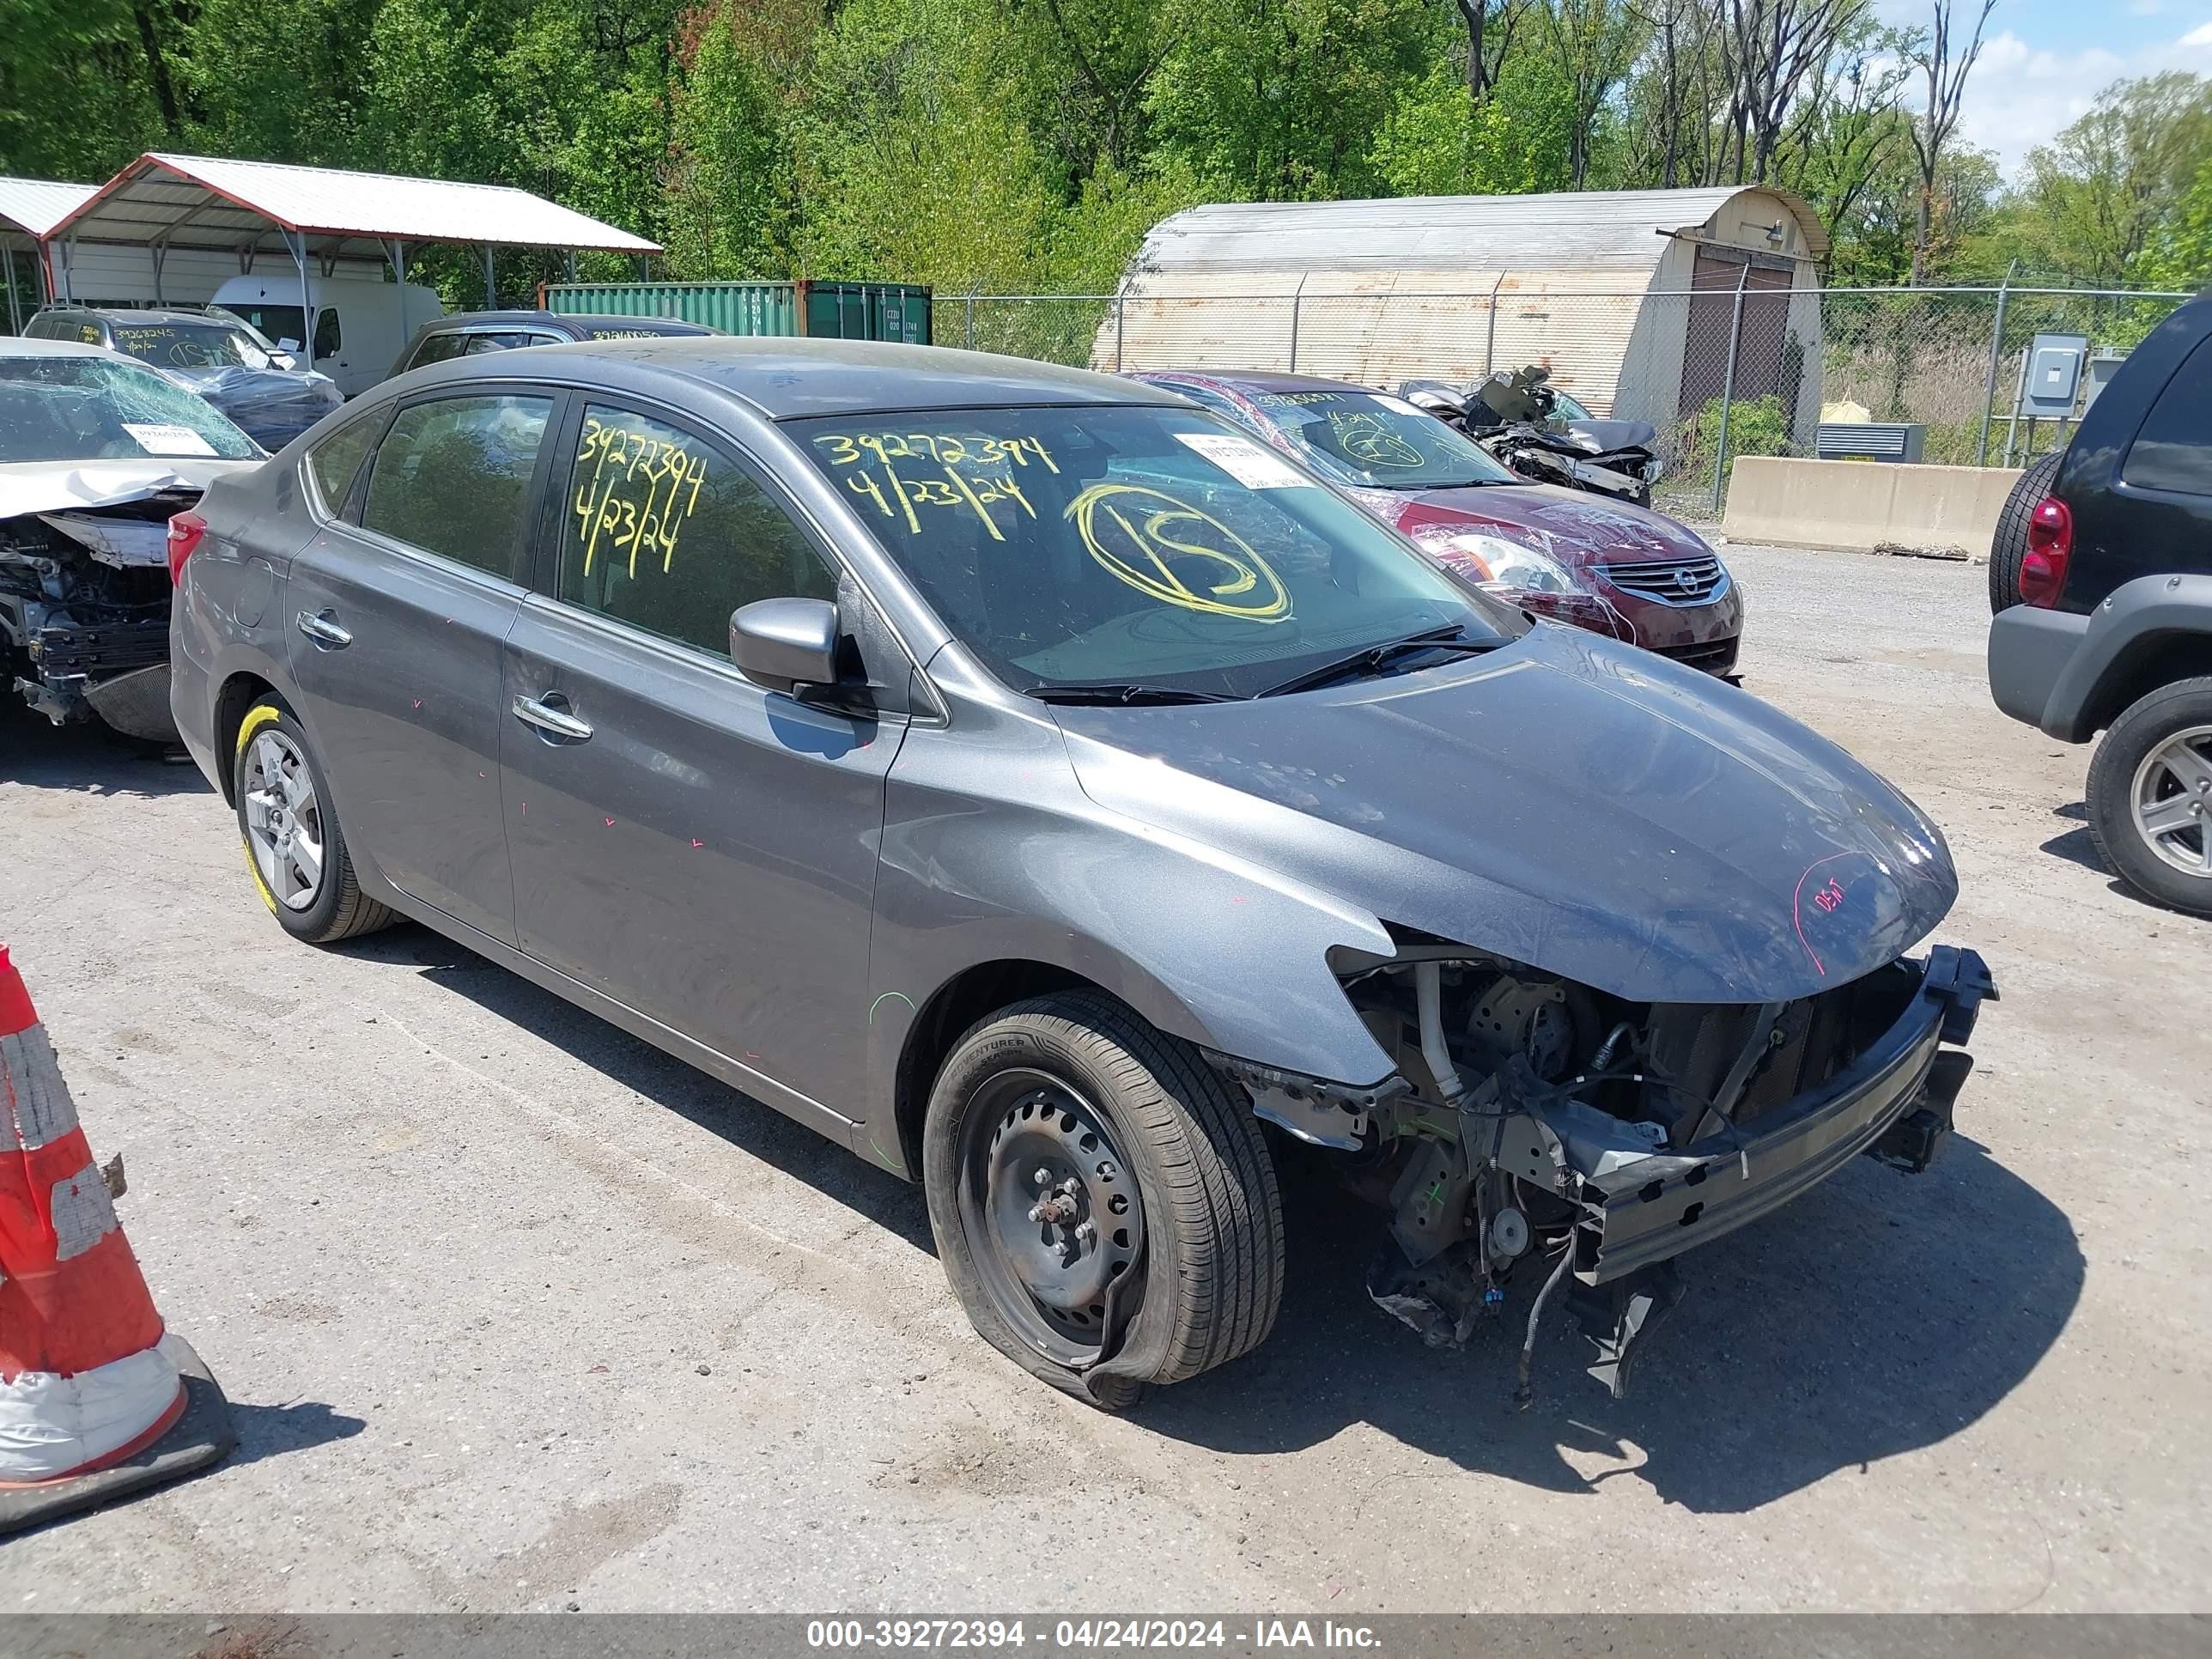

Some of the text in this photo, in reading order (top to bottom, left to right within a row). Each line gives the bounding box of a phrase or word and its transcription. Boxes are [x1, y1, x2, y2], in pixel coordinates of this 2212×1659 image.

[578, 418, 708, 518] 39272394
[812, 434, 1061, 473] 39272394
[576, 472, 684, 580] 4/23/24
[847, 464, 1037, 542] 4/23/24
